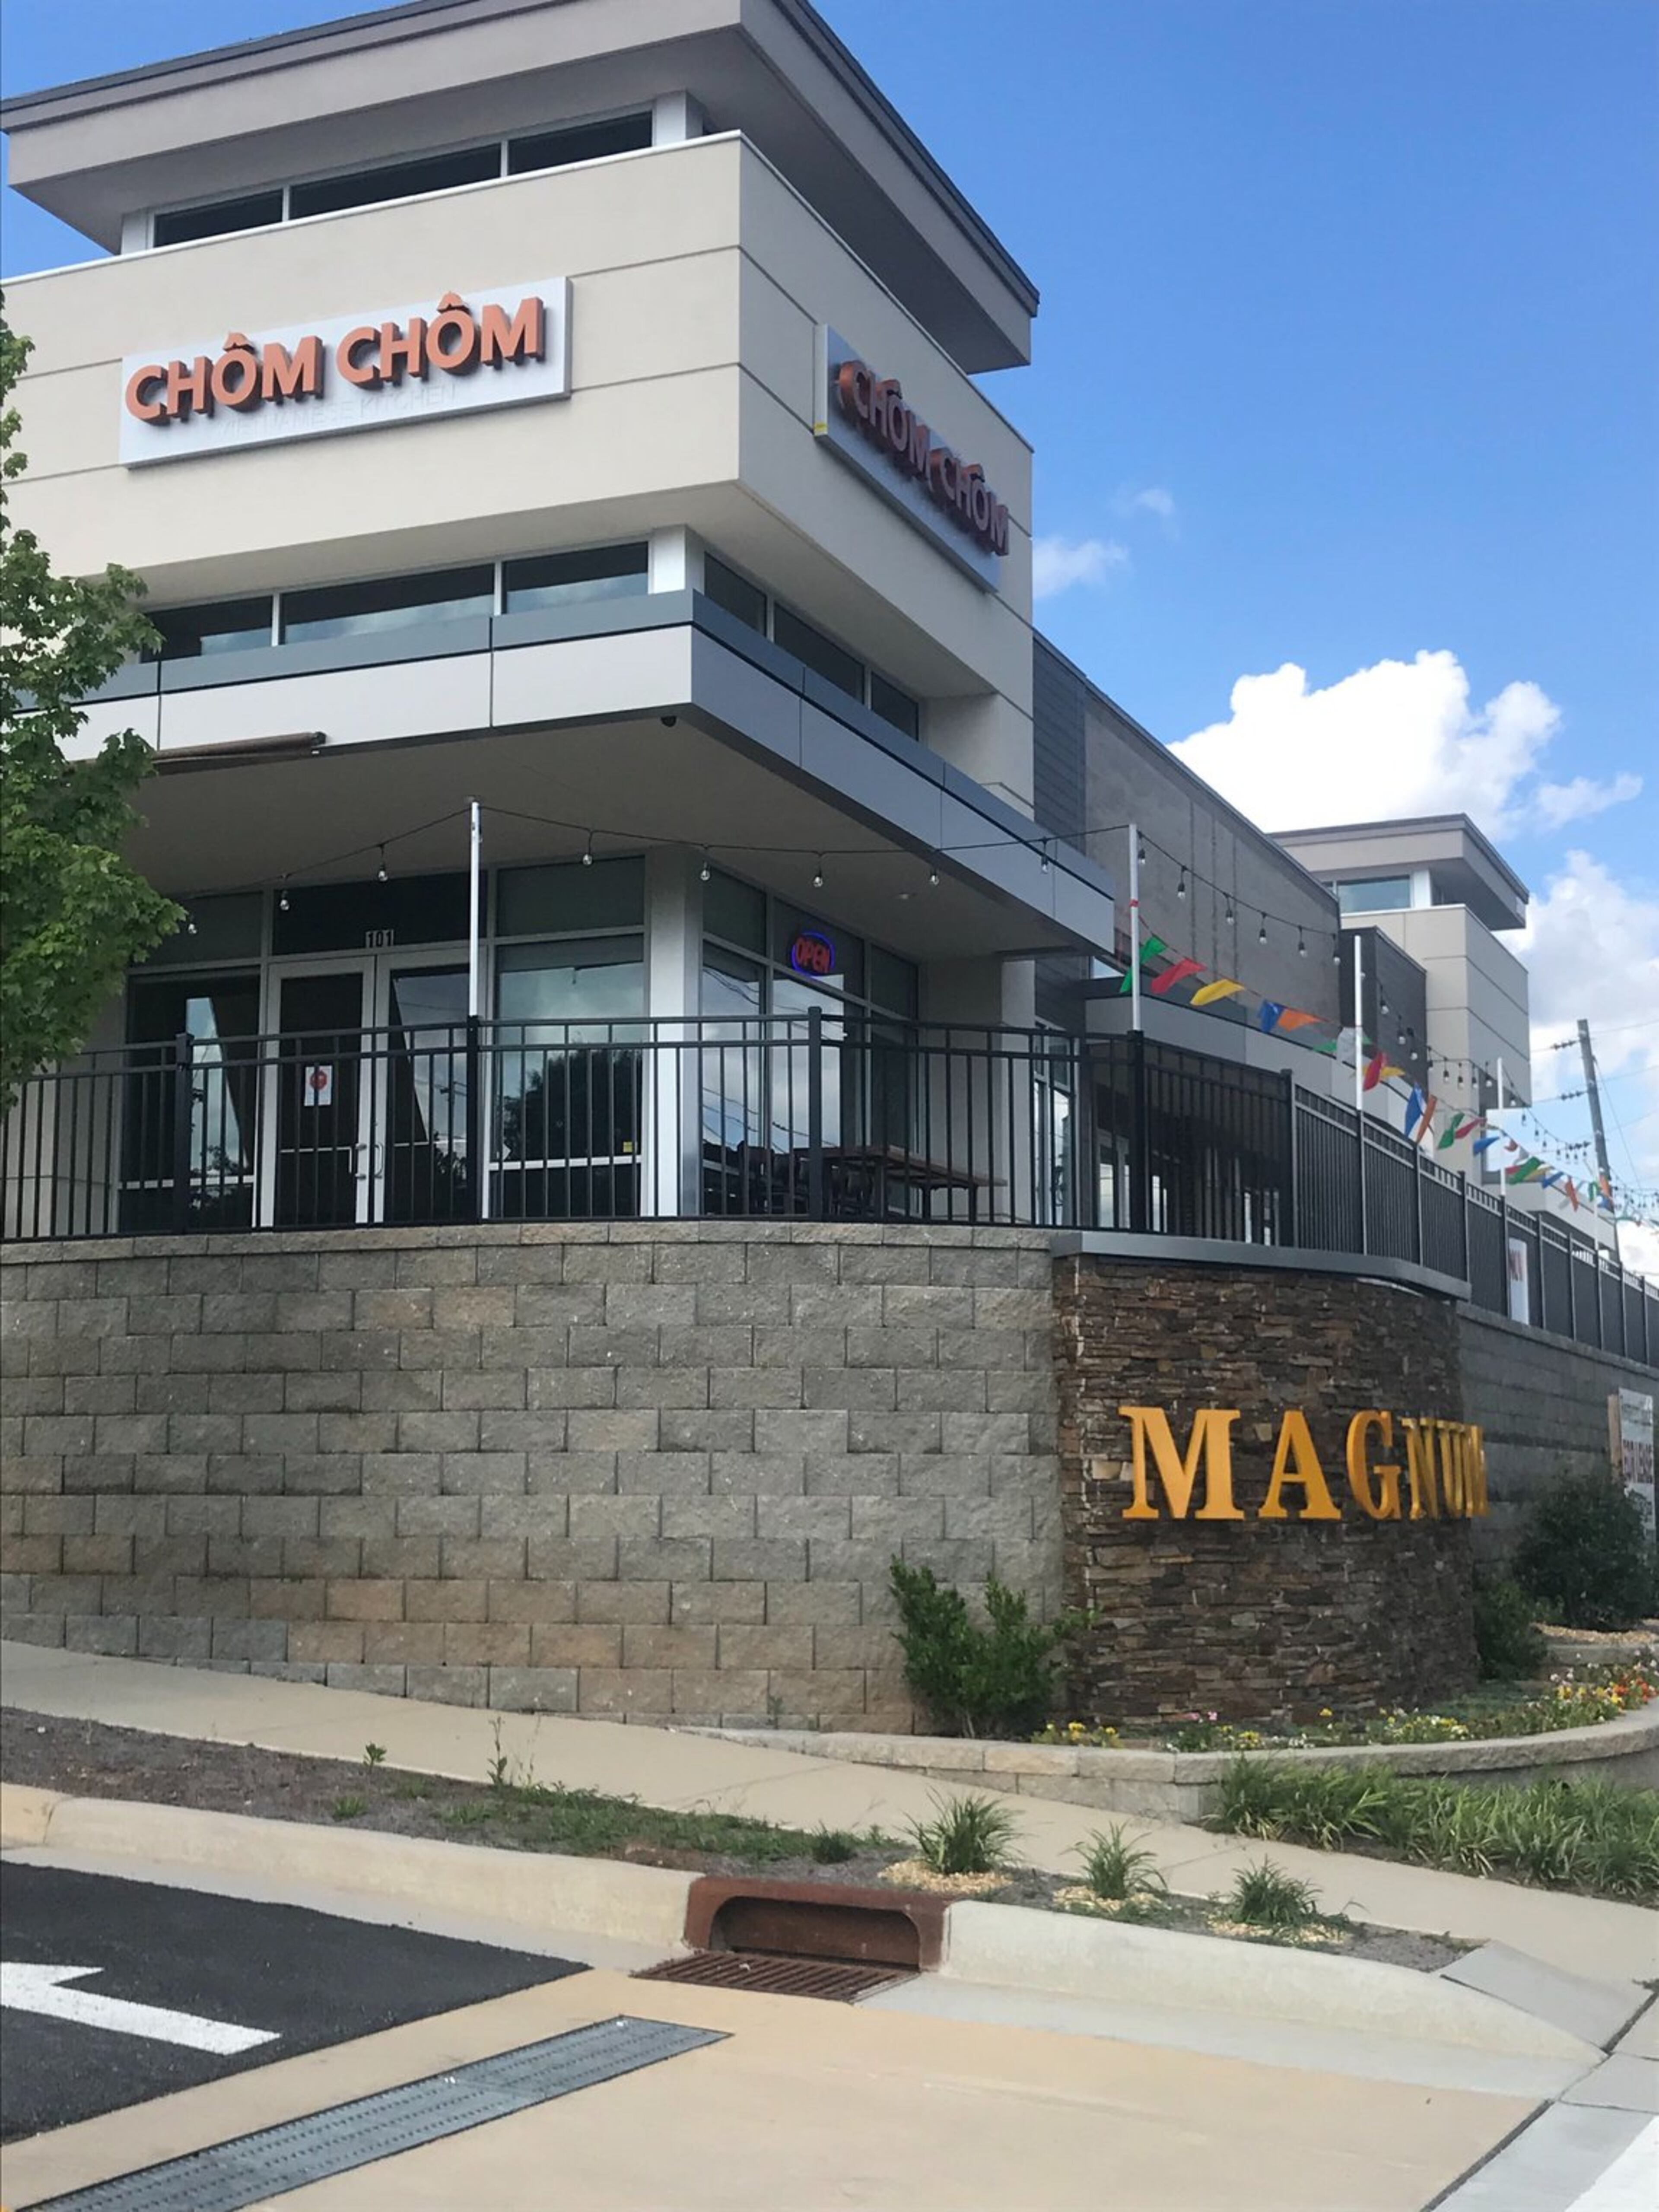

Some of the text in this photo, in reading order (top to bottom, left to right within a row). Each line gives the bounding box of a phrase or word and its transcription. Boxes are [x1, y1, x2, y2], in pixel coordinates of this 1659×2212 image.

[125, 291, 545, 423] CHÔM CHÔM
[837, 359, 1009, 556] CHÔM CHÔM
[367, 930, 392, 948] 101
[796, 936, 830, 974] OPEN
[1118, 1406, 1489, 1521] MAGNUM
